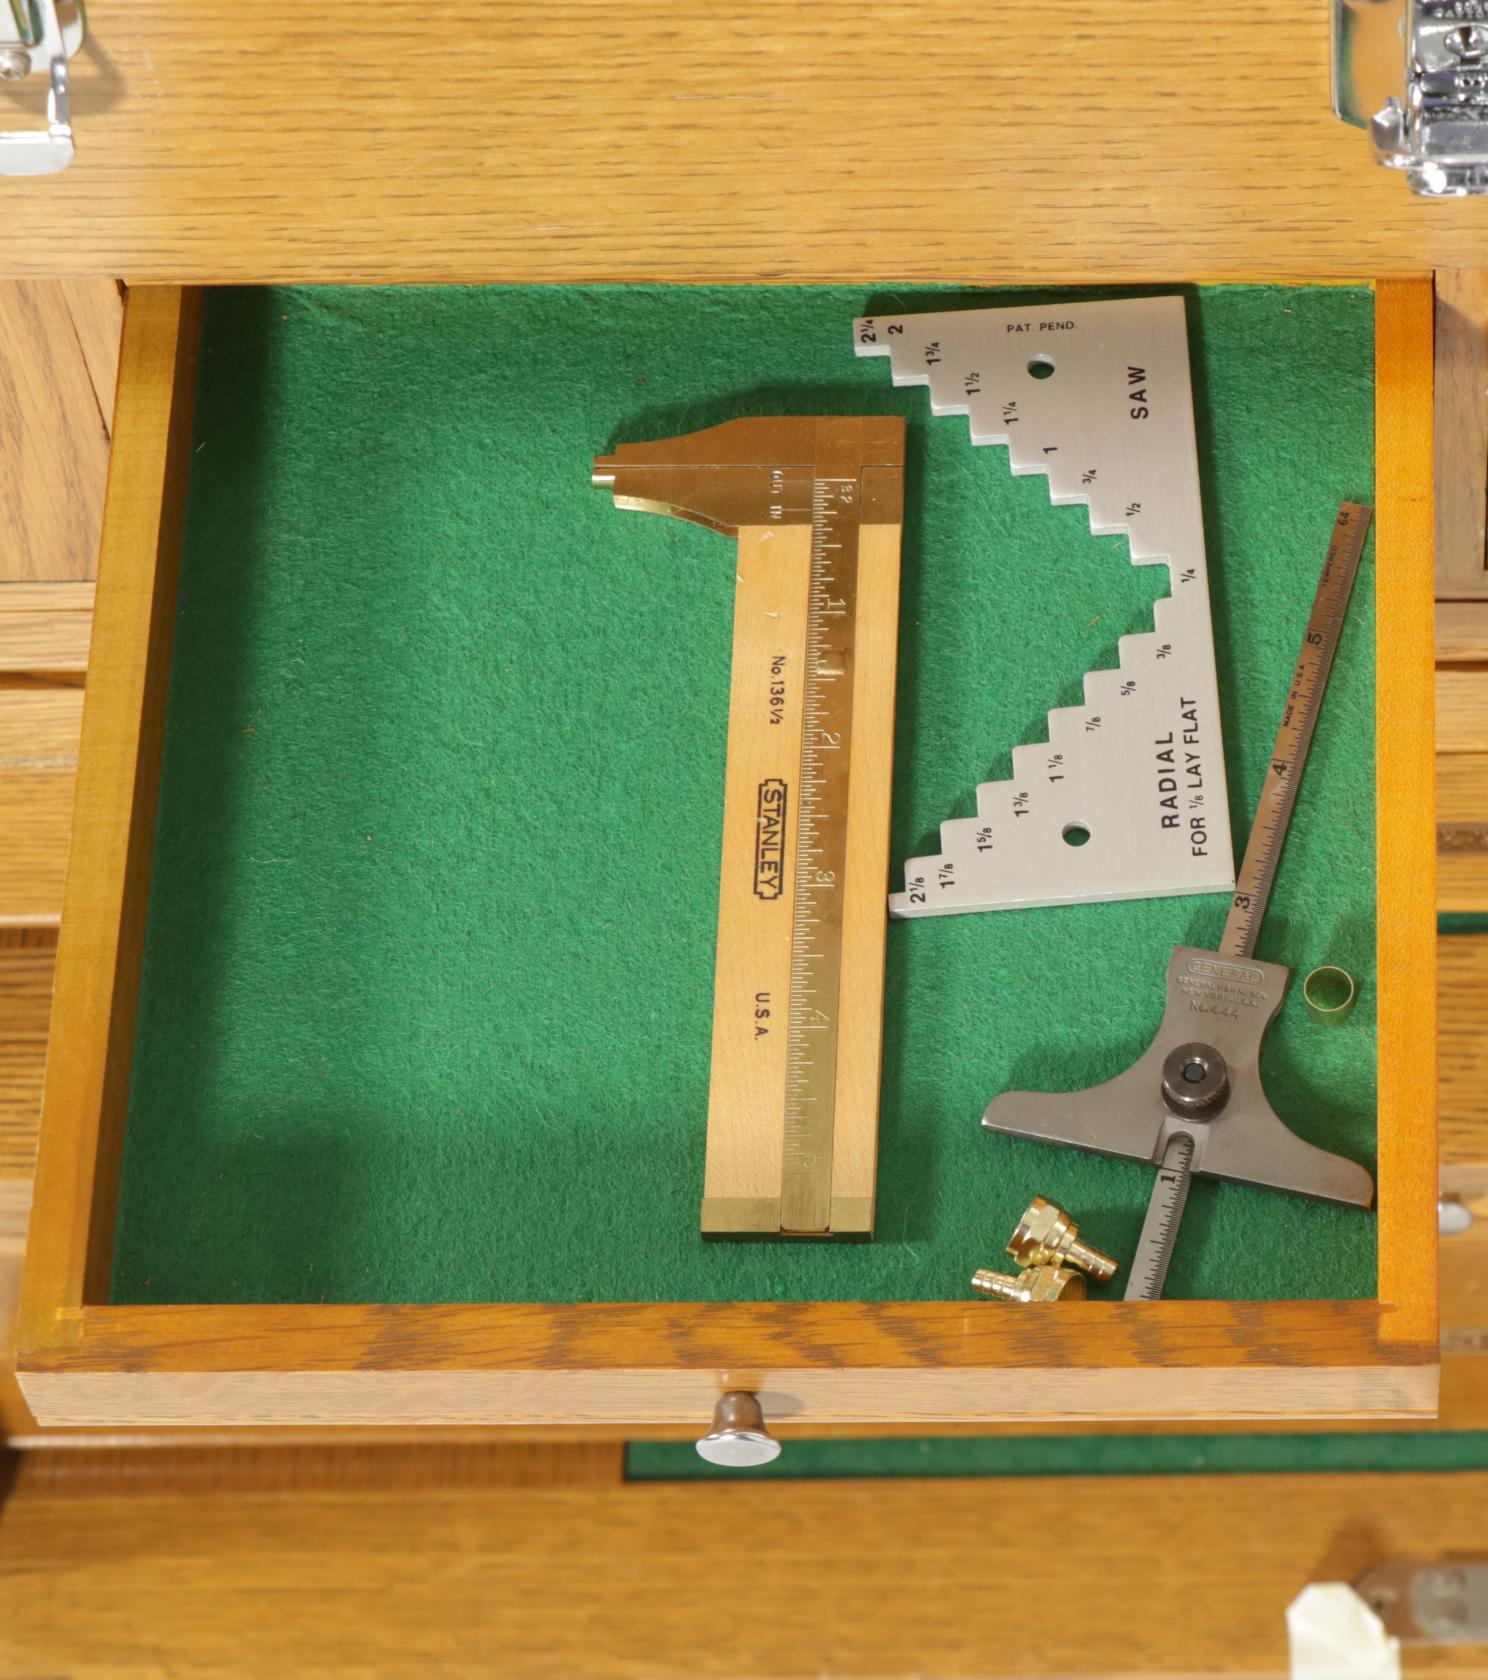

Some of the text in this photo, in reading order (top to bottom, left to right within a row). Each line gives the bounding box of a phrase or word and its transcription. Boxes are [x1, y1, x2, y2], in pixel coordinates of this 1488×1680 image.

[888, 324, 904, 335] 2
[1006, 320, 1078, 333] PAT. PEND.
[1128, 366, 1149, 420] SAW
[1042, 445, 1058, 454] 1
[1307, 632, 1322, 645] 5
[1180, 697, 1199, 745] FLAT
[821, 731, 841, 745] 2
[1184, 749, 1203, 788] LAY
[1272, 762, 1287, 776] 4
[1155, 731, 1180, 829] RADIAL
[759, 788, 783, 889] STANLEY
[1190, 816, 1208, 857] FOR
[816, 870, 836, 883] 3
[1234, 895, 1251, 909] 3
[1191, 960, 1260, 982] GENERAL
[754, 992, 771, 1041] U.S.A.
[1160, 1174, 1176, 1184] 1
